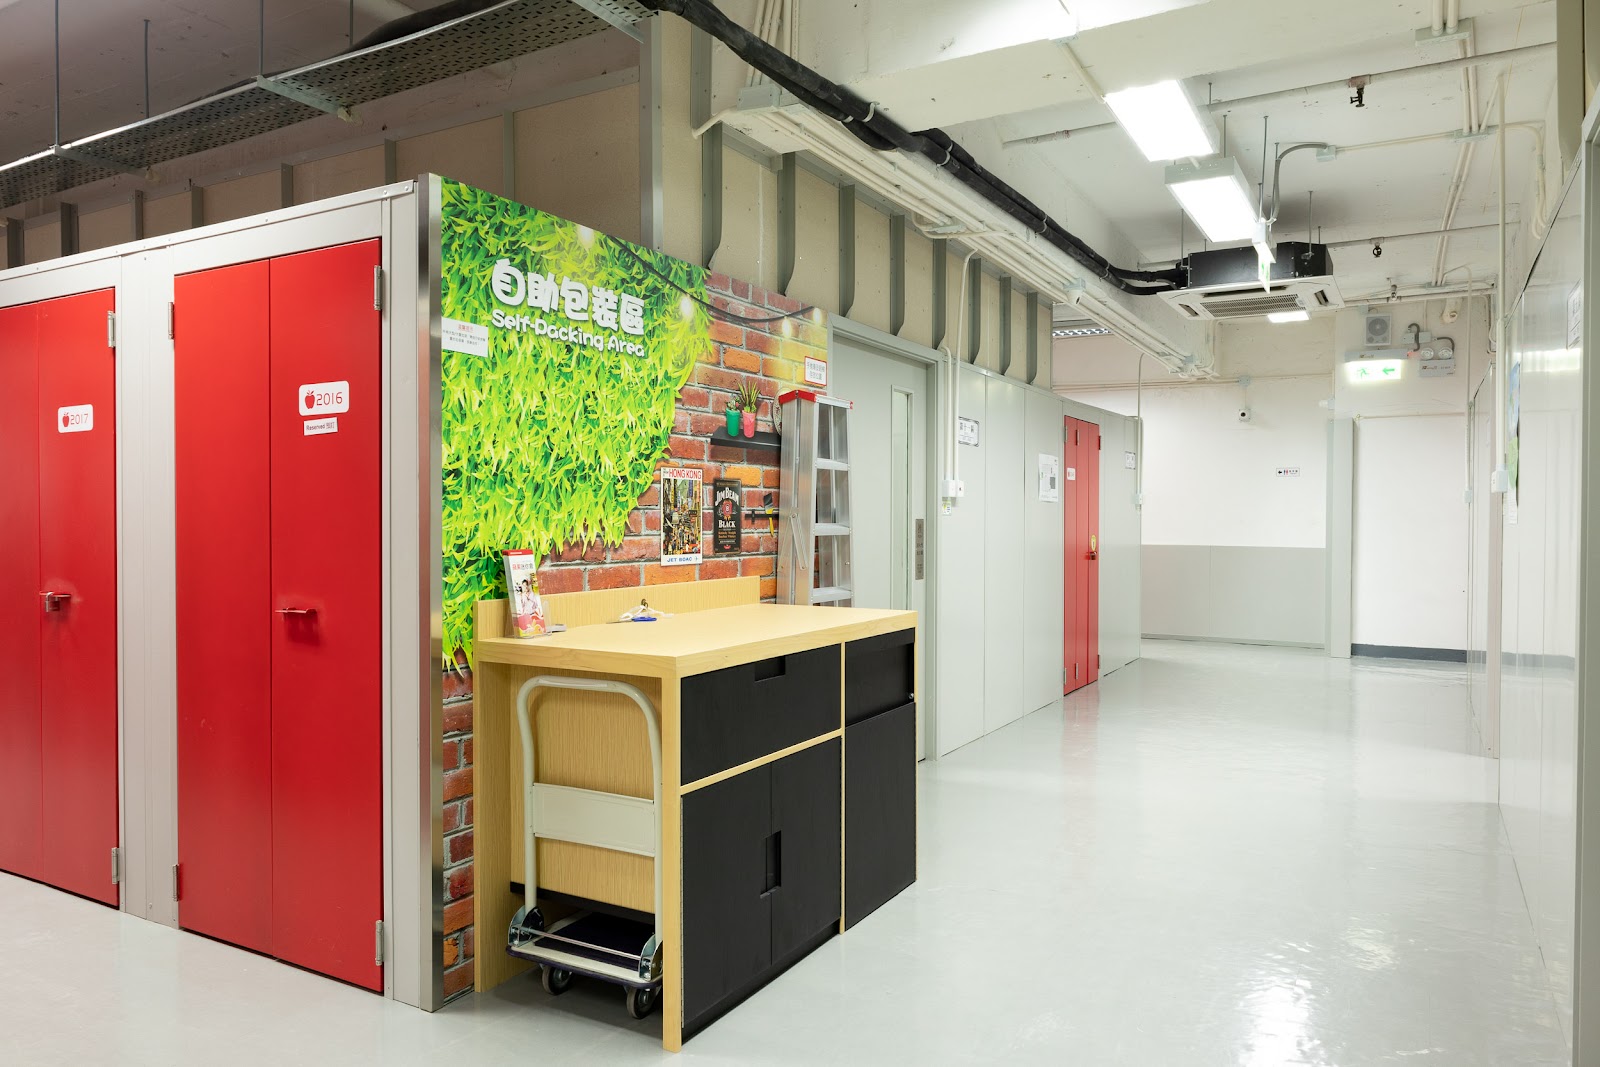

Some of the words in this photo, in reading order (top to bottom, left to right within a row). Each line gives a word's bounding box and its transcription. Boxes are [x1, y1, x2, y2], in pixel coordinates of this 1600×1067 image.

[491, 258, 645, 336] 自助包裝區
[607, 335, 645, 357] Area
[316, 391, 343, 406] 2016
[70, 413, 89, 425] 2017
[669, 468, 685, 478] HONG
[686, 470, 702, 480] KONG
[718, 520, 736, 528] BLACK
